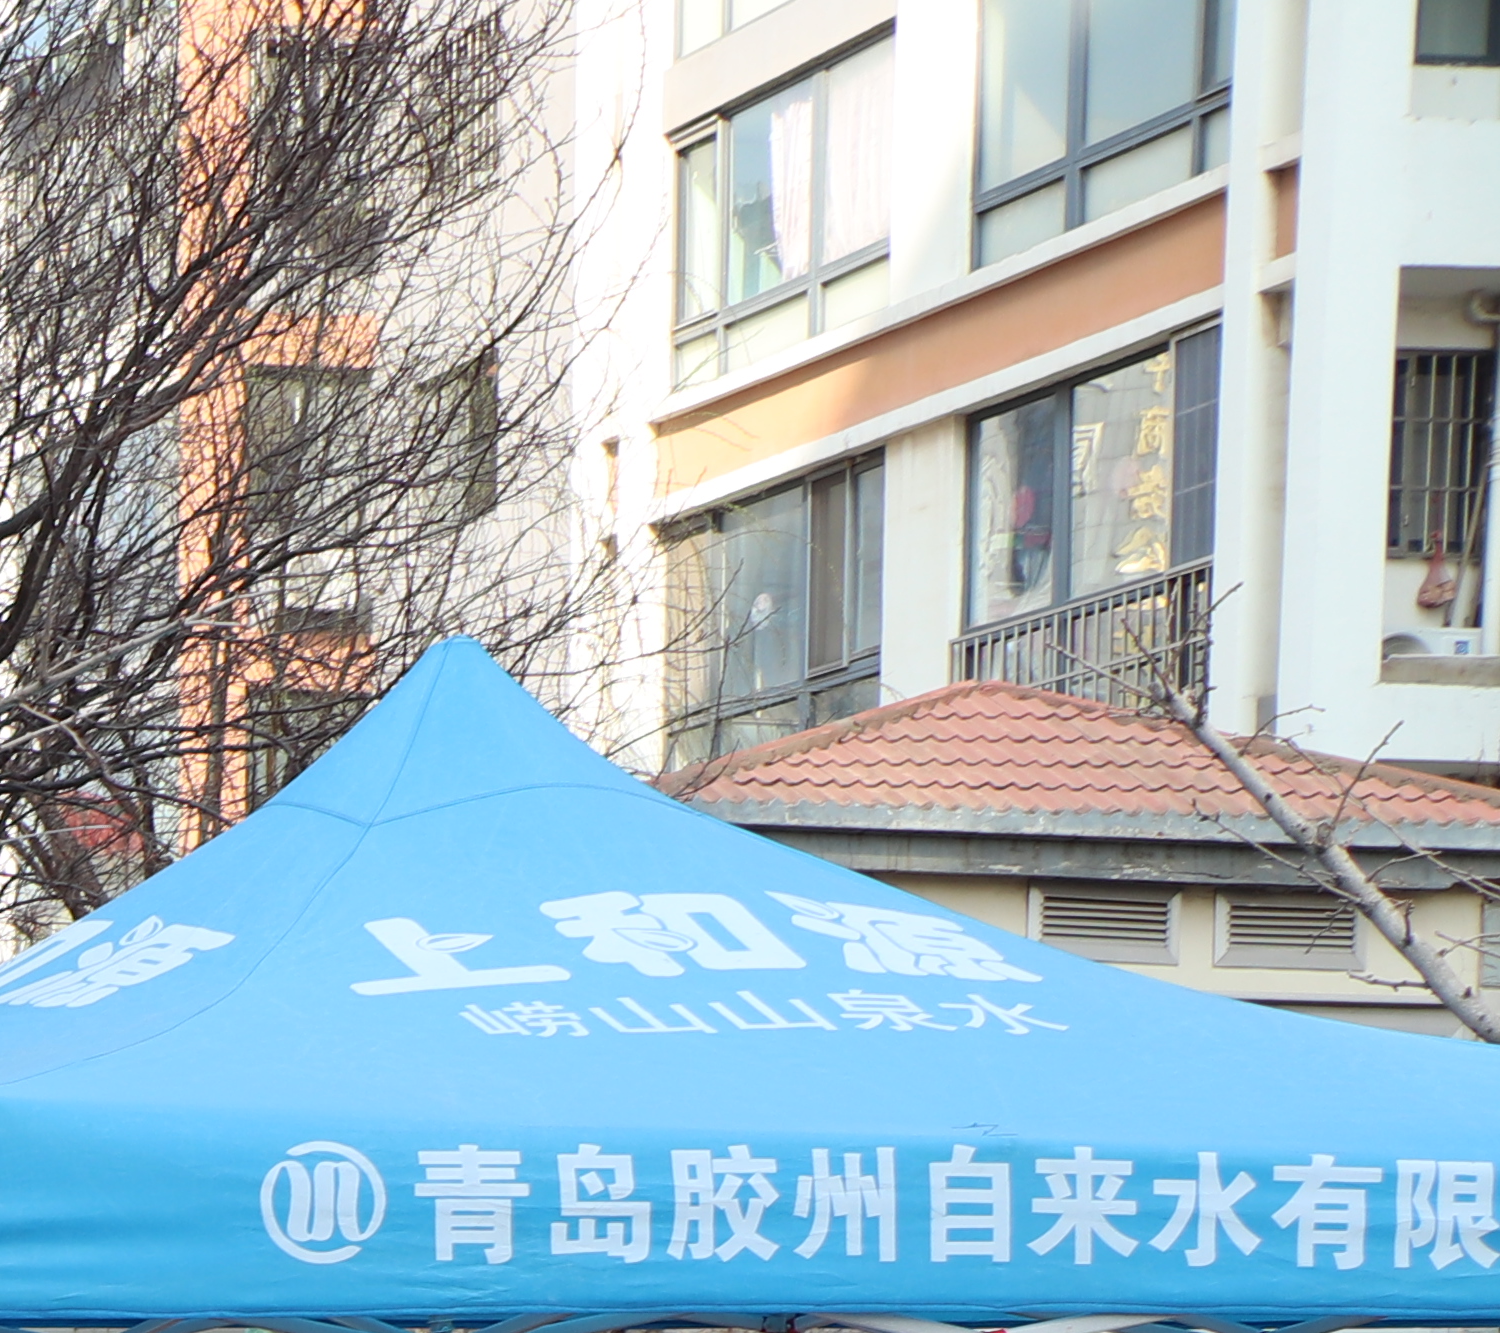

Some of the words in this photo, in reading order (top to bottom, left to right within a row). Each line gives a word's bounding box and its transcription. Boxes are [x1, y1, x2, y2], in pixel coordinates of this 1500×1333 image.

[348, 888, 1045, 998] 上和源
[458, 987, 1071, 1038] 崂山山泉水
[412, 1142, 1500, 1271] 青岛胶州自来水有限
